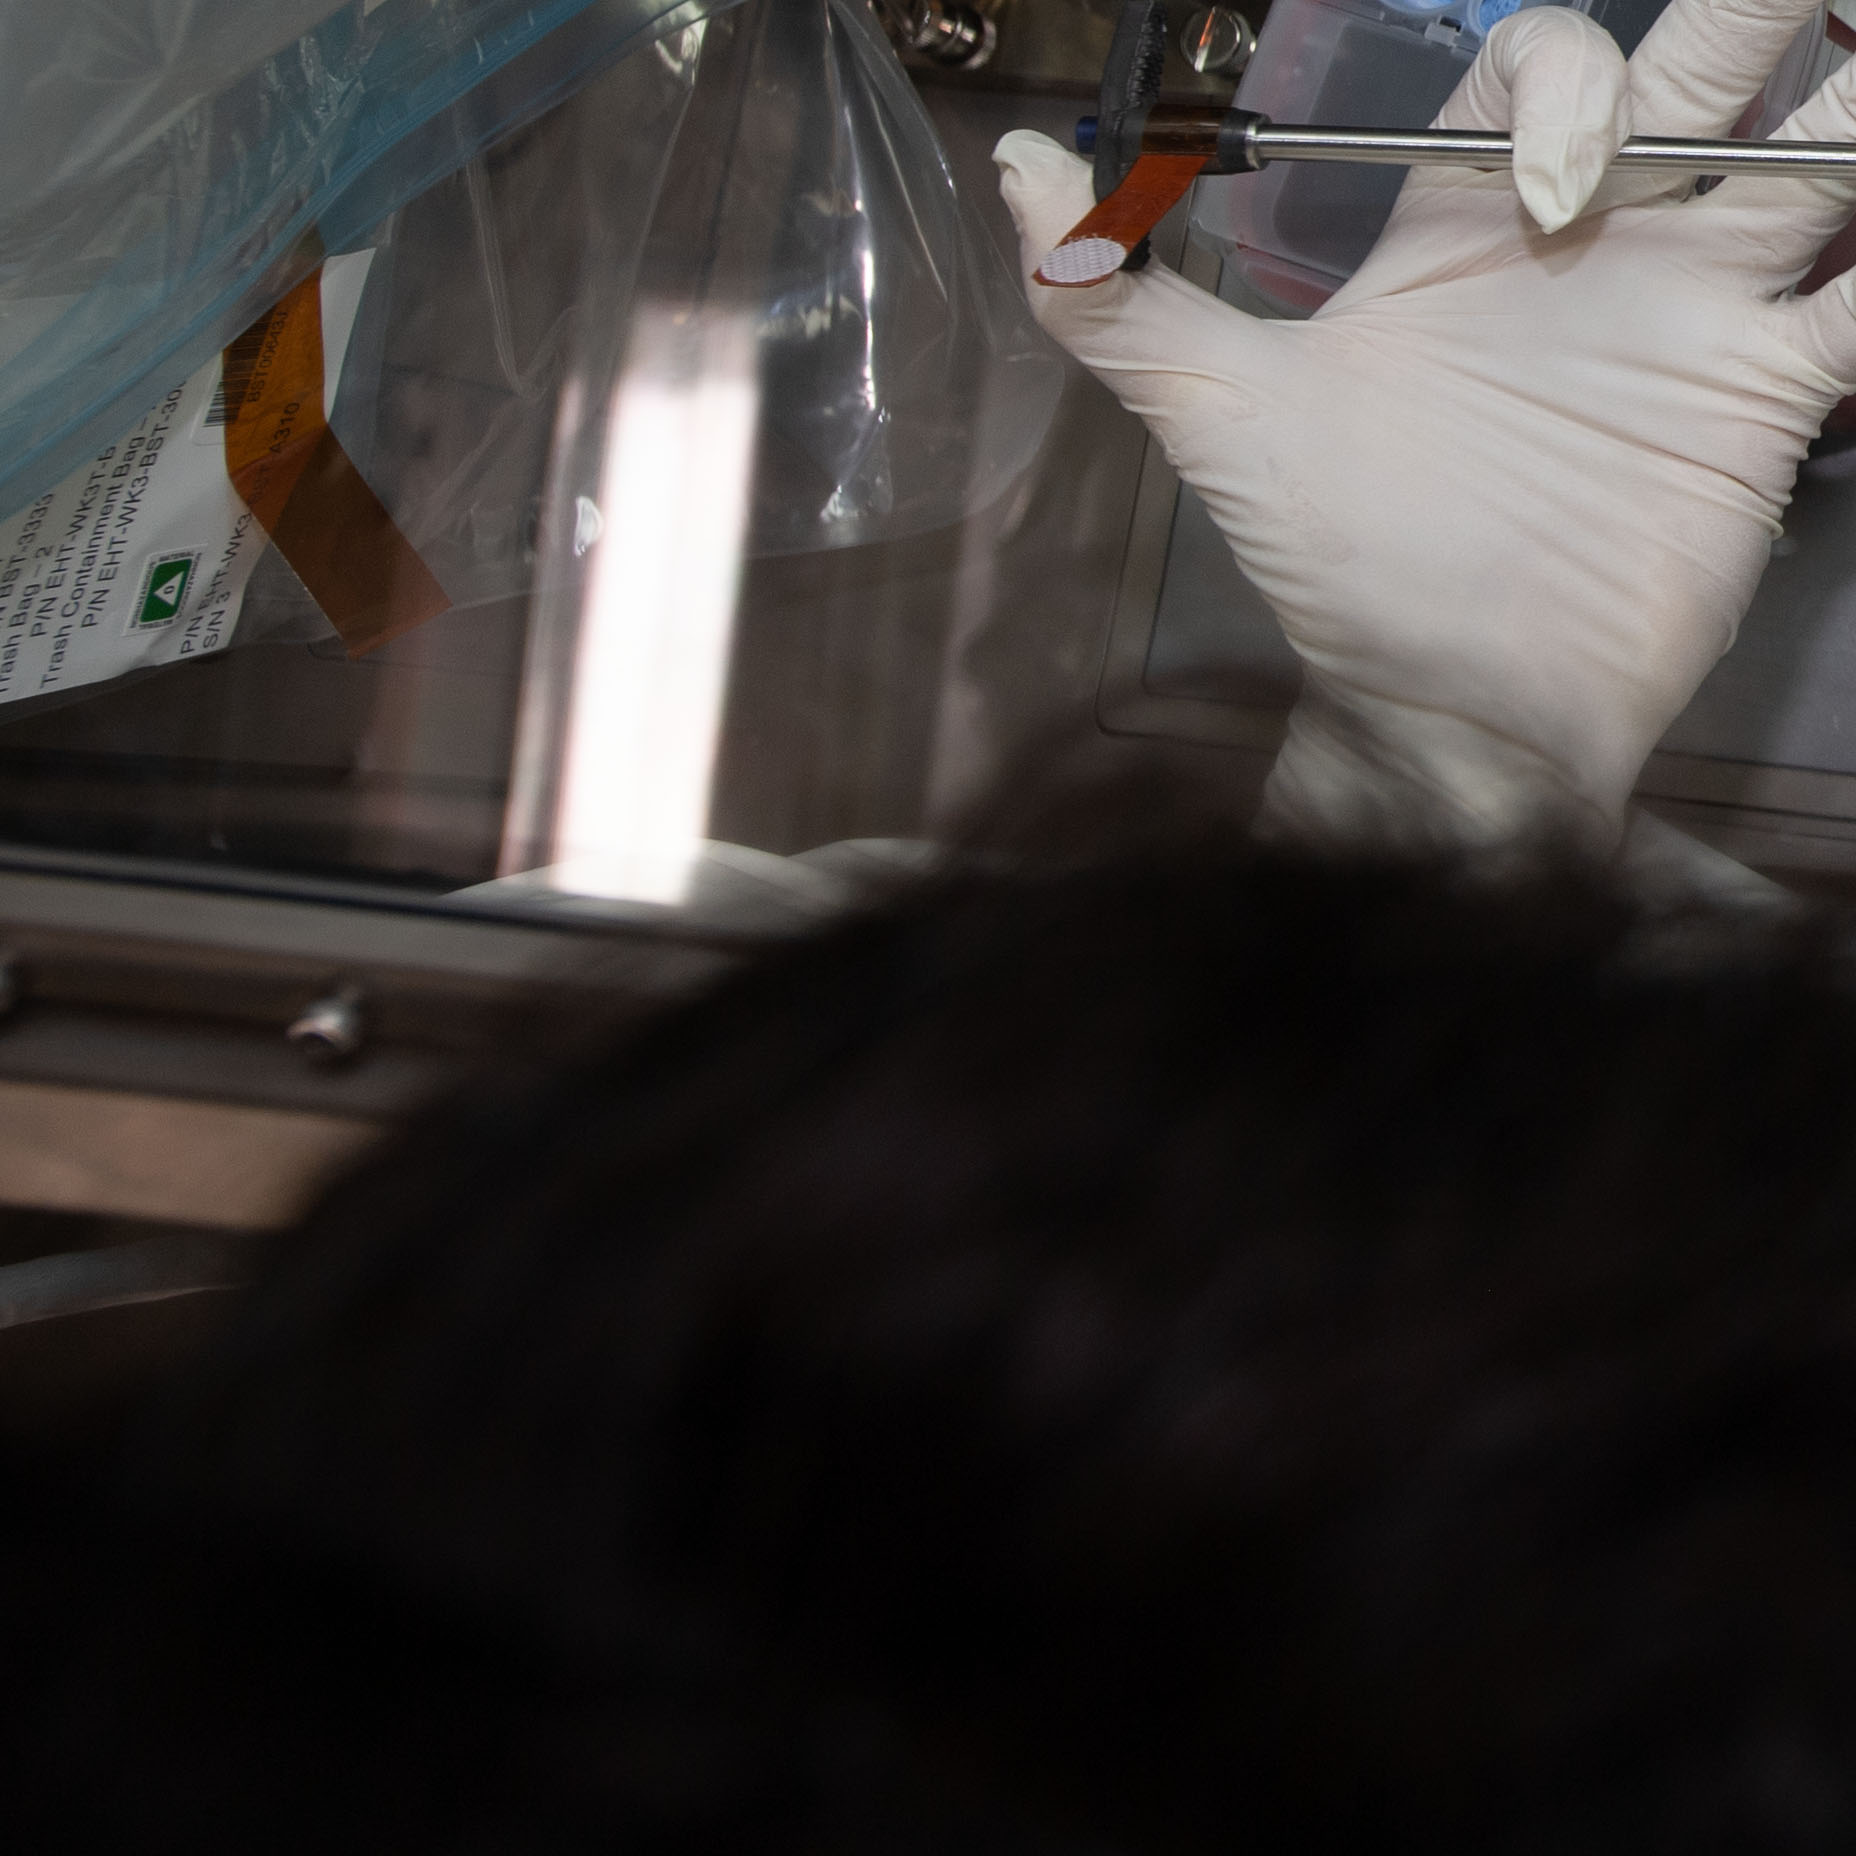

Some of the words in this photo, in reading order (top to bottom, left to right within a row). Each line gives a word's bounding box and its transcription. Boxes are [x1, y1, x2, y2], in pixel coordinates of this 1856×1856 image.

[81, 590, 110, 628] P/N
[98, 381, 187, 584] EHT-WK3-BST-30
[9, 584, 41, 628] Bag
[36, 546, 53, 559] 2
[39, 625, 72, 689] Trash
[61, 485, 124, 618] Containment
[111, 437, 145, 480] Bag
[30, 597, 56, 637] P/N
[181, 616, 204, 655] P/N
[203, 609, 226, 648] S/N
